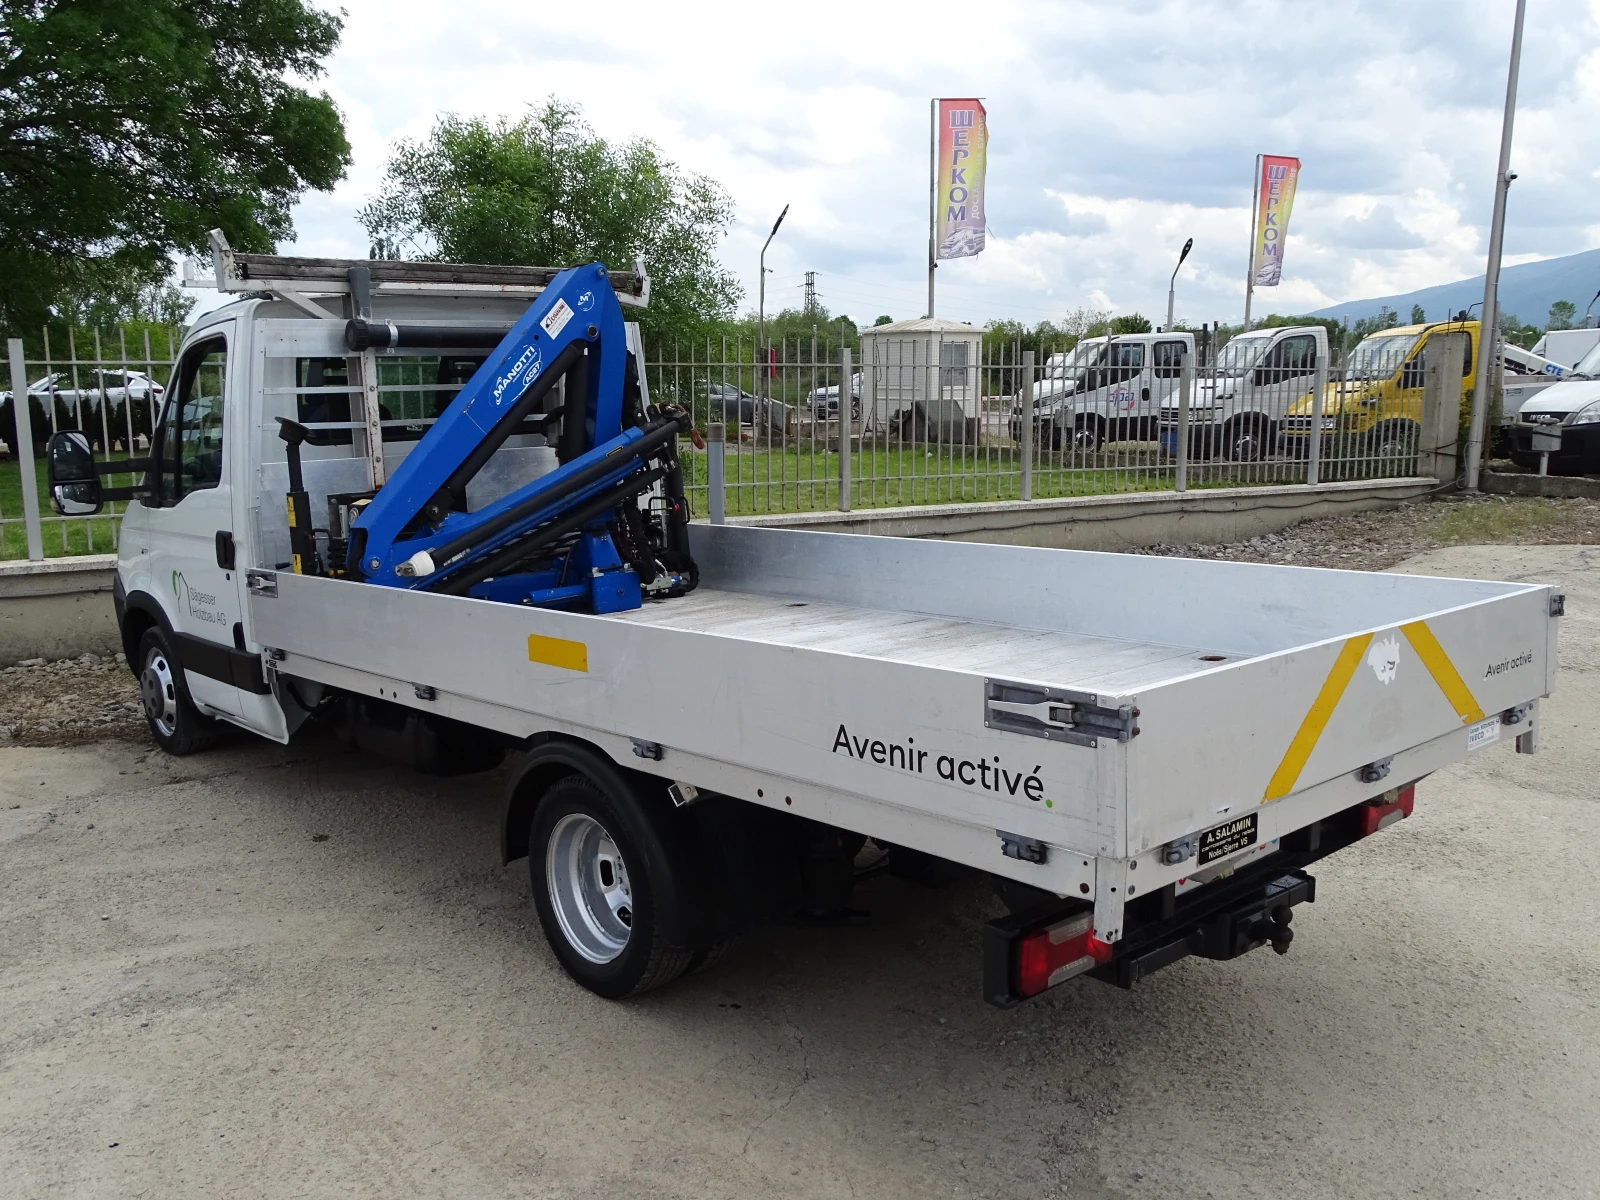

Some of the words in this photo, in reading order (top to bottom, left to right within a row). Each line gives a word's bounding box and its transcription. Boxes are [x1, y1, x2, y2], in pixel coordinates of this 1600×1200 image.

[947, 110, 974, 222] ШЕРКОМ
[1262, 165, 1288, 256] ШЕРКОМ
[493, 346, 536, 398] MANOTTI
[525, 361, 540, 382] AC27
[1545, 364, 1563, 377] CTE
[191, 605, 216, 624] Holzbau
[216, 611, 227, 627] AG
[1485, 657, 1510, 678] Avenir
[1510, 649, 1532, 670] activé
[832, 724, 928, 773] Avenir
[1469, 731, 1485, 743] IVECO
[1206, 832, 1215, 844] A.
[1215, 817, 1251, 840] SALAMIN
[1240, 836, 1248, 846] VS
